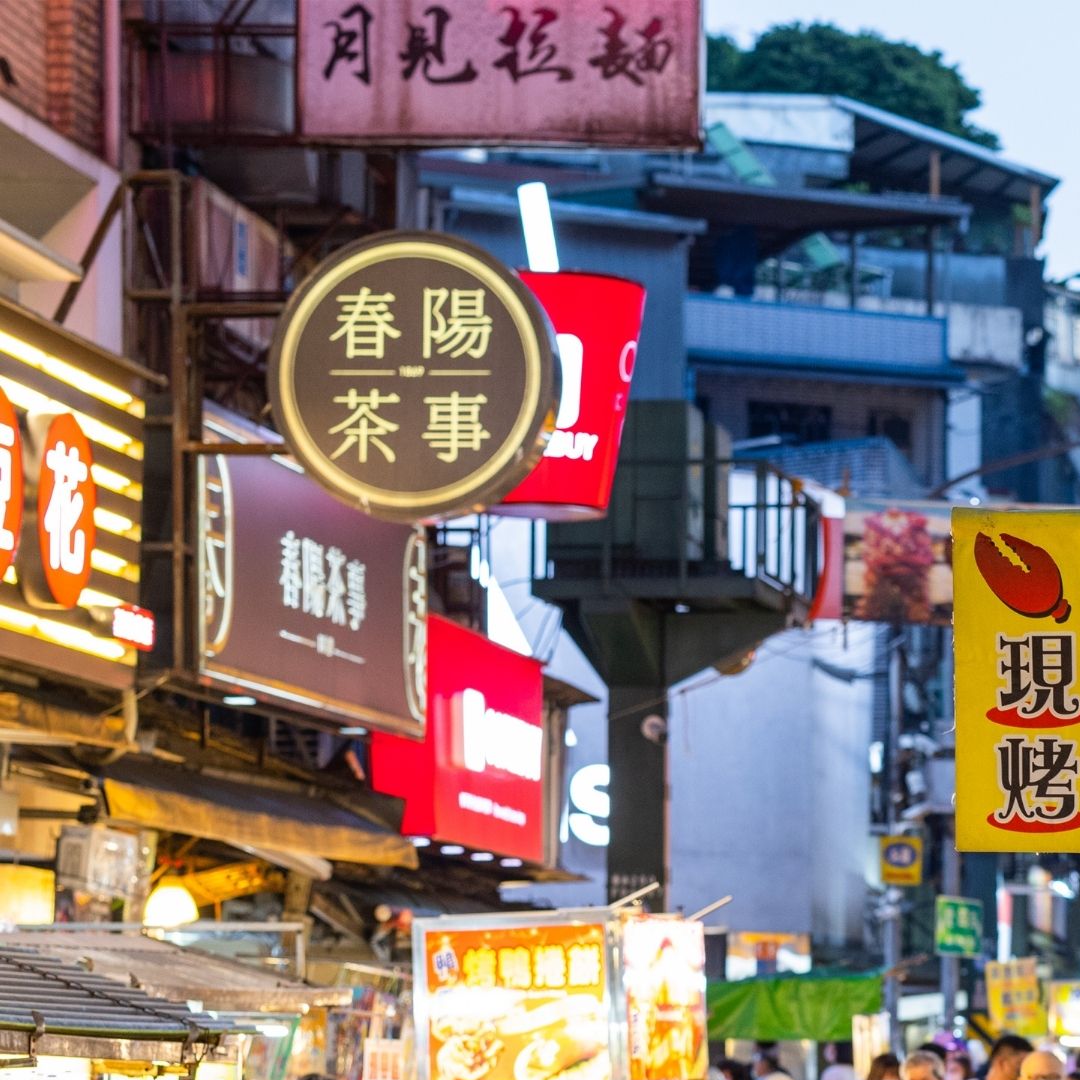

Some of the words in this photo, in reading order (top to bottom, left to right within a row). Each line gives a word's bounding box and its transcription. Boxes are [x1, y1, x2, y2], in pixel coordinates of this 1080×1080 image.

[324, 4, 673, 86] 月見拉麵
[329, 286, 493, 359] 春陽
[328, 388, 491, 463] 茶事
